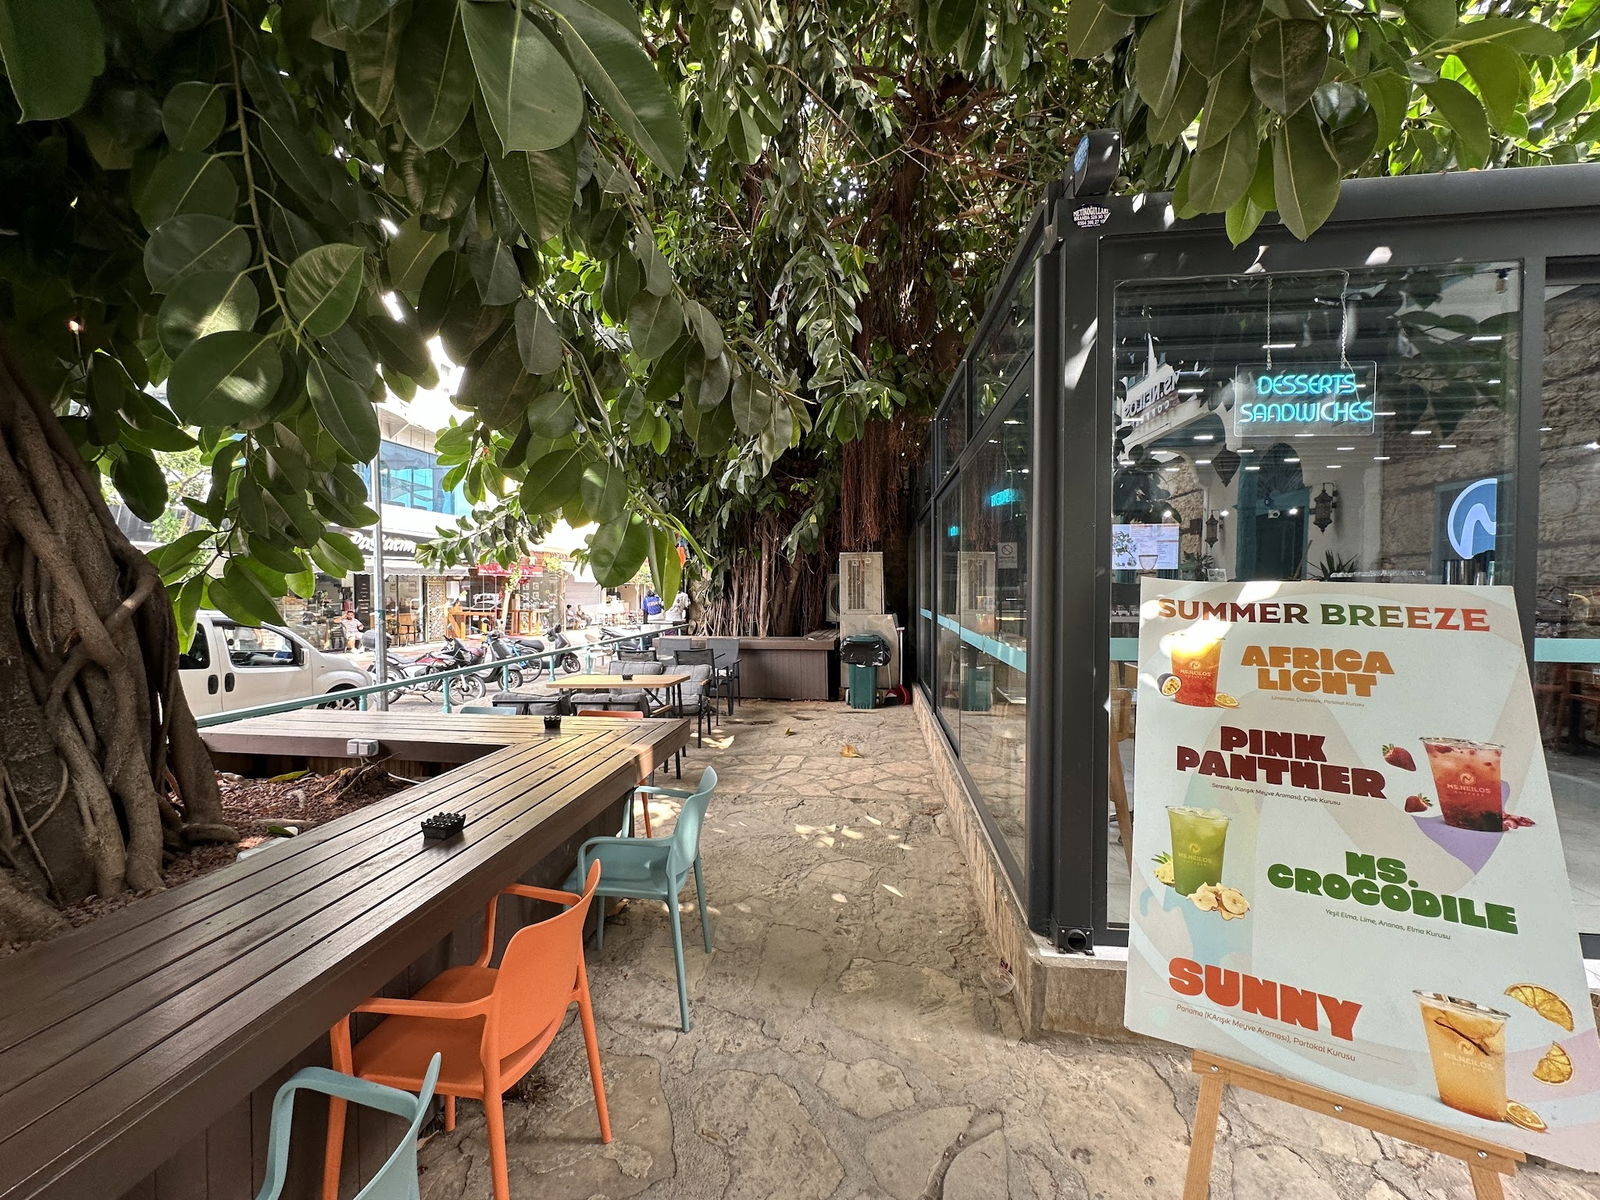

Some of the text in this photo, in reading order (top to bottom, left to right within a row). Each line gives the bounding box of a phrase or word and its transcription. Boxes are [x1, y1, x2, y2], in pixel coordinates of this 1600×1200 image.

[1257, 374, 1357, 395] DESSERTS
[1239, 401, 1374, 422] SANDWICHES
[1158, 598, 1491, 632] SUMMER BREEZE
[1240, 645, 1395, 675] AFRICA
[1257, 667, 1377, 697] LIGHT
[1220, 725, 1327, 762] PINK
[1176, 745, 1387, 800] PANTHER
[1255, 789, 1275, 798] Meyve
[1303, 795, 1318, 803] Çilek
[1319, 797, 1341, 806] Kurusu
[1345, 850, 1419, 888] MS.
[1267, 863, 1519, 934] CROCODILE
[1325, 908, 1451, 940] Yeşil Elma, Lime, Ananas, Elma Kurusu
[1168, 957, 1363, 1041] SUNNY
[1176, 1004, 1204, 1018] Panama
[1232, 1019, 1256, 1033] Meyve
[1327, 1048, 1356, 1062] Kurusu
